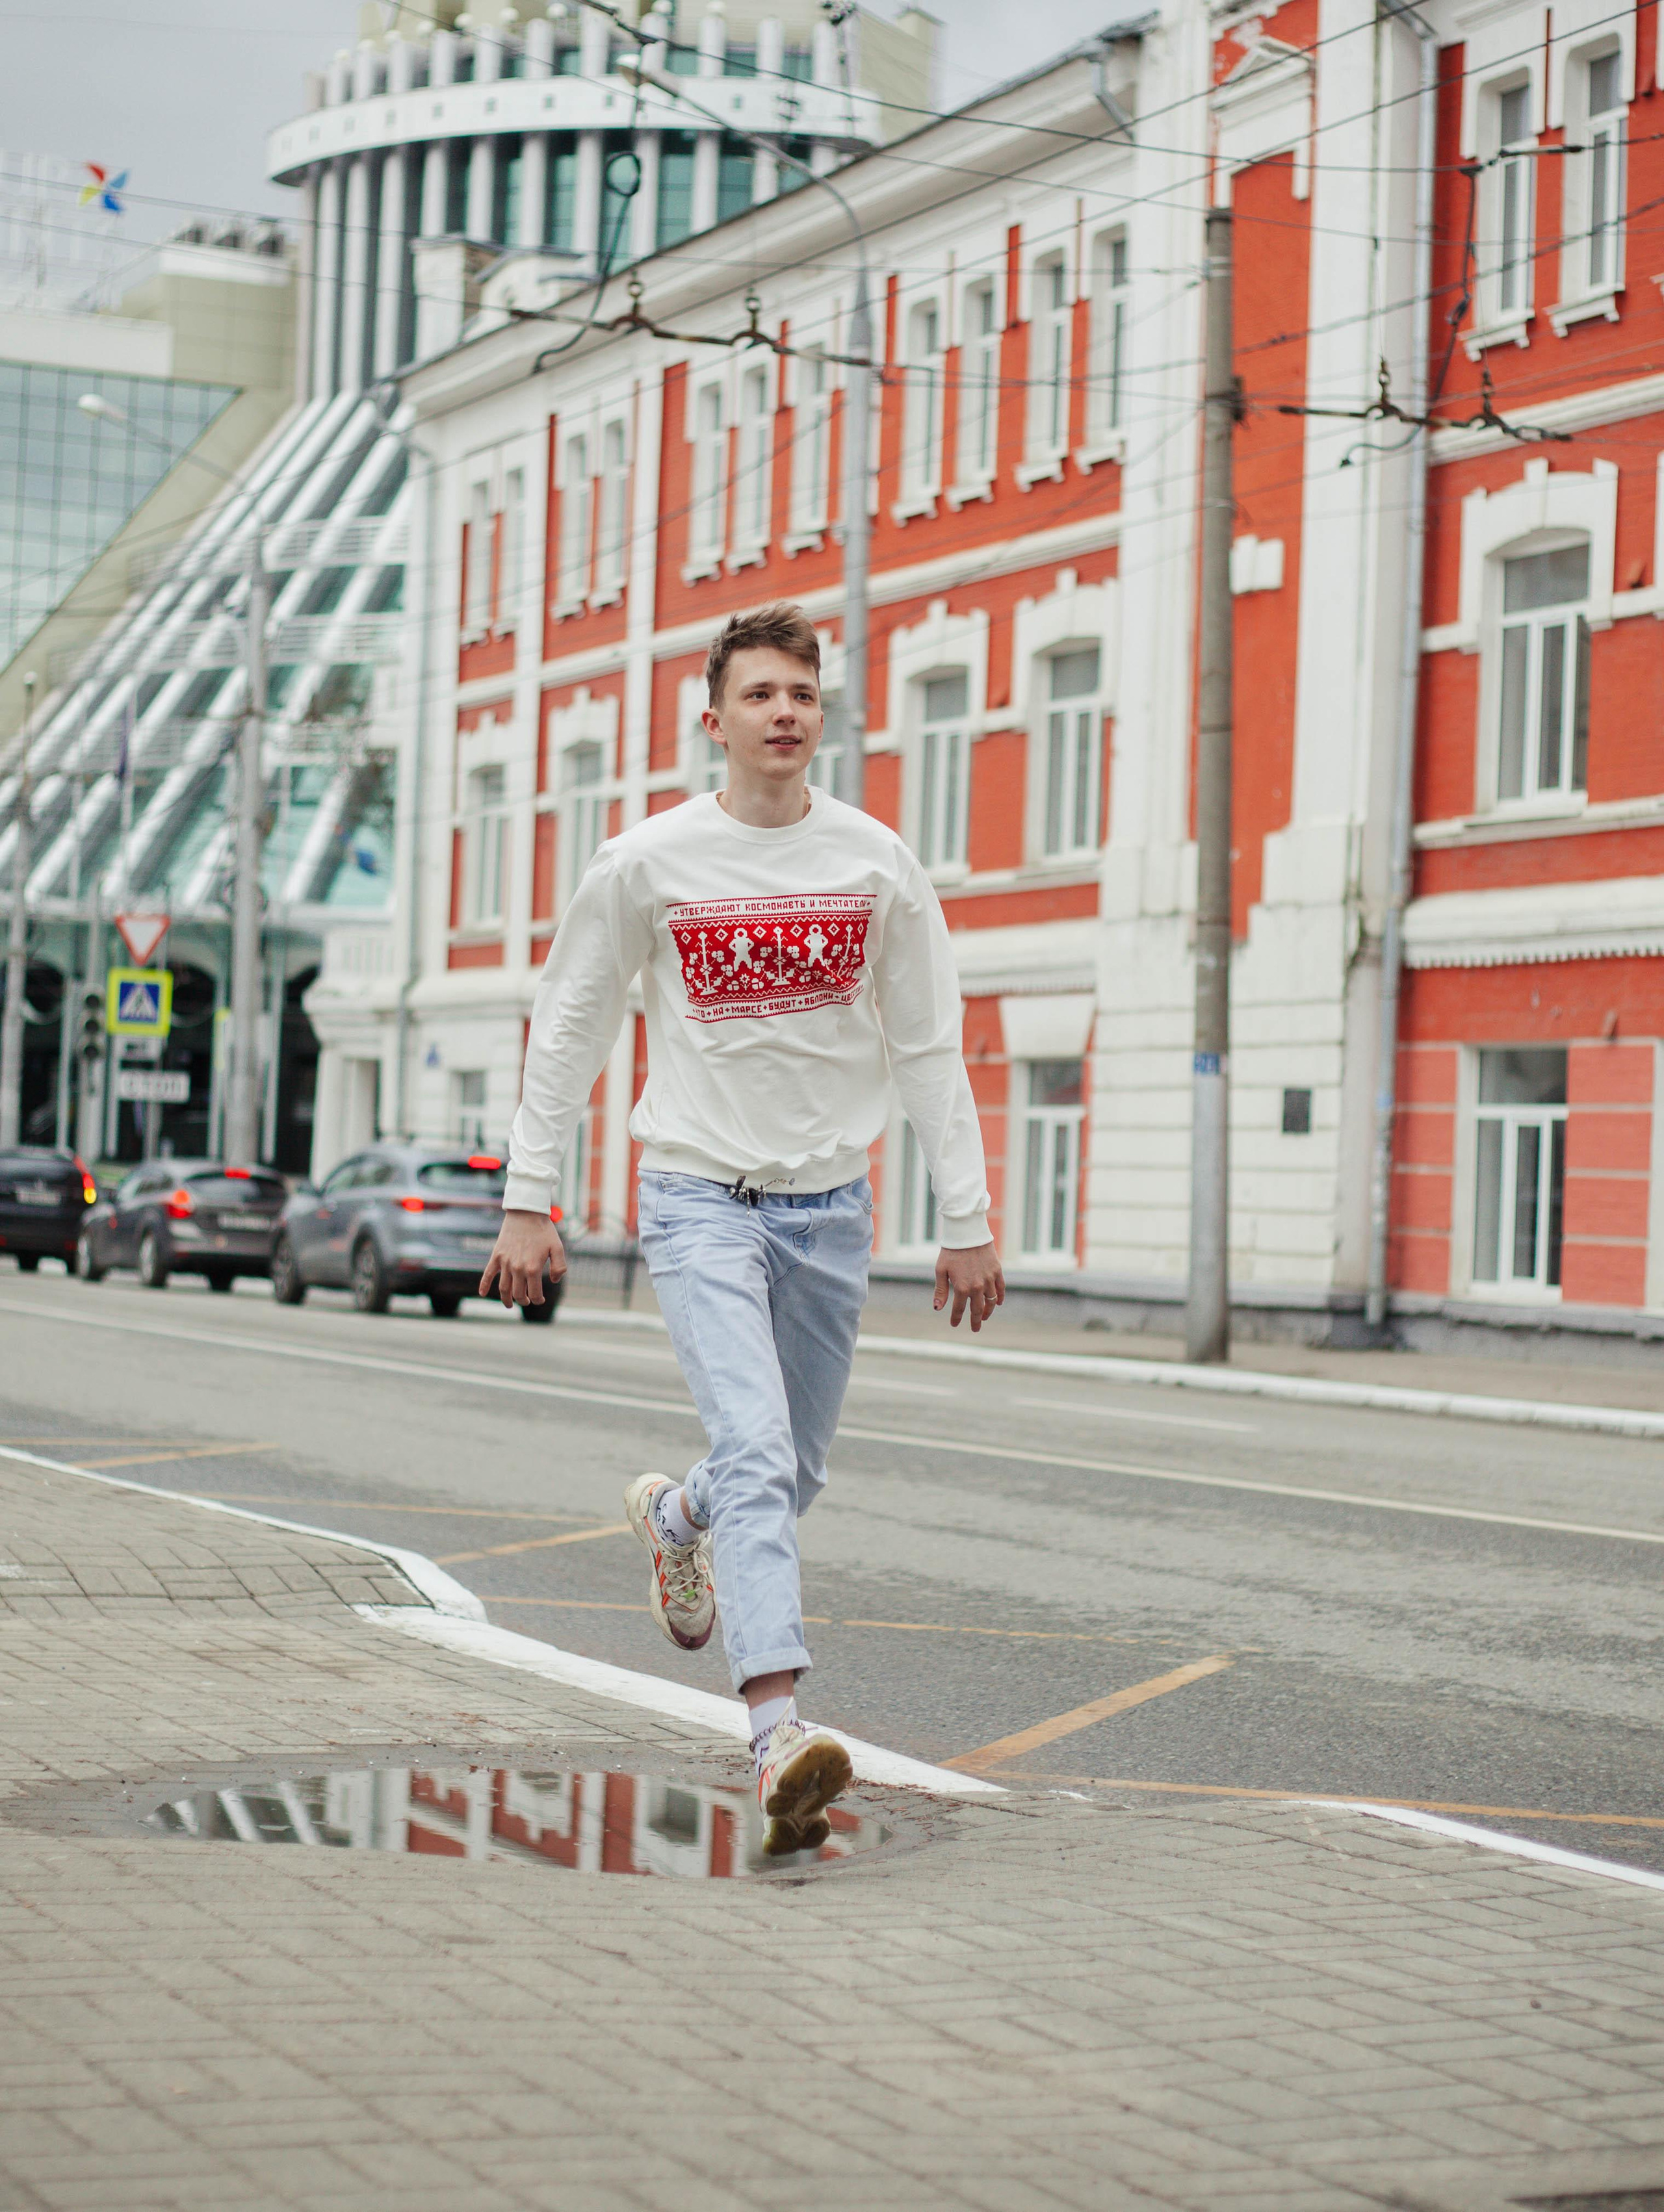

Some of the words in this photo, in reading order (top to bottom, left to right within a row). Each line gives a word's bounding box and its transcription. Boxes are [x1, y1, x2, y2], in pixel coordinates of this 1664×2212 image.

[680, 904, 740, 916] УТВЕРЖДАЮТ
[713, 1007, 723, 1016] НА
[768, 999, 796, 1010] БУДУТ
[805, 992, 833, 1005] ЯБЛОНИ
